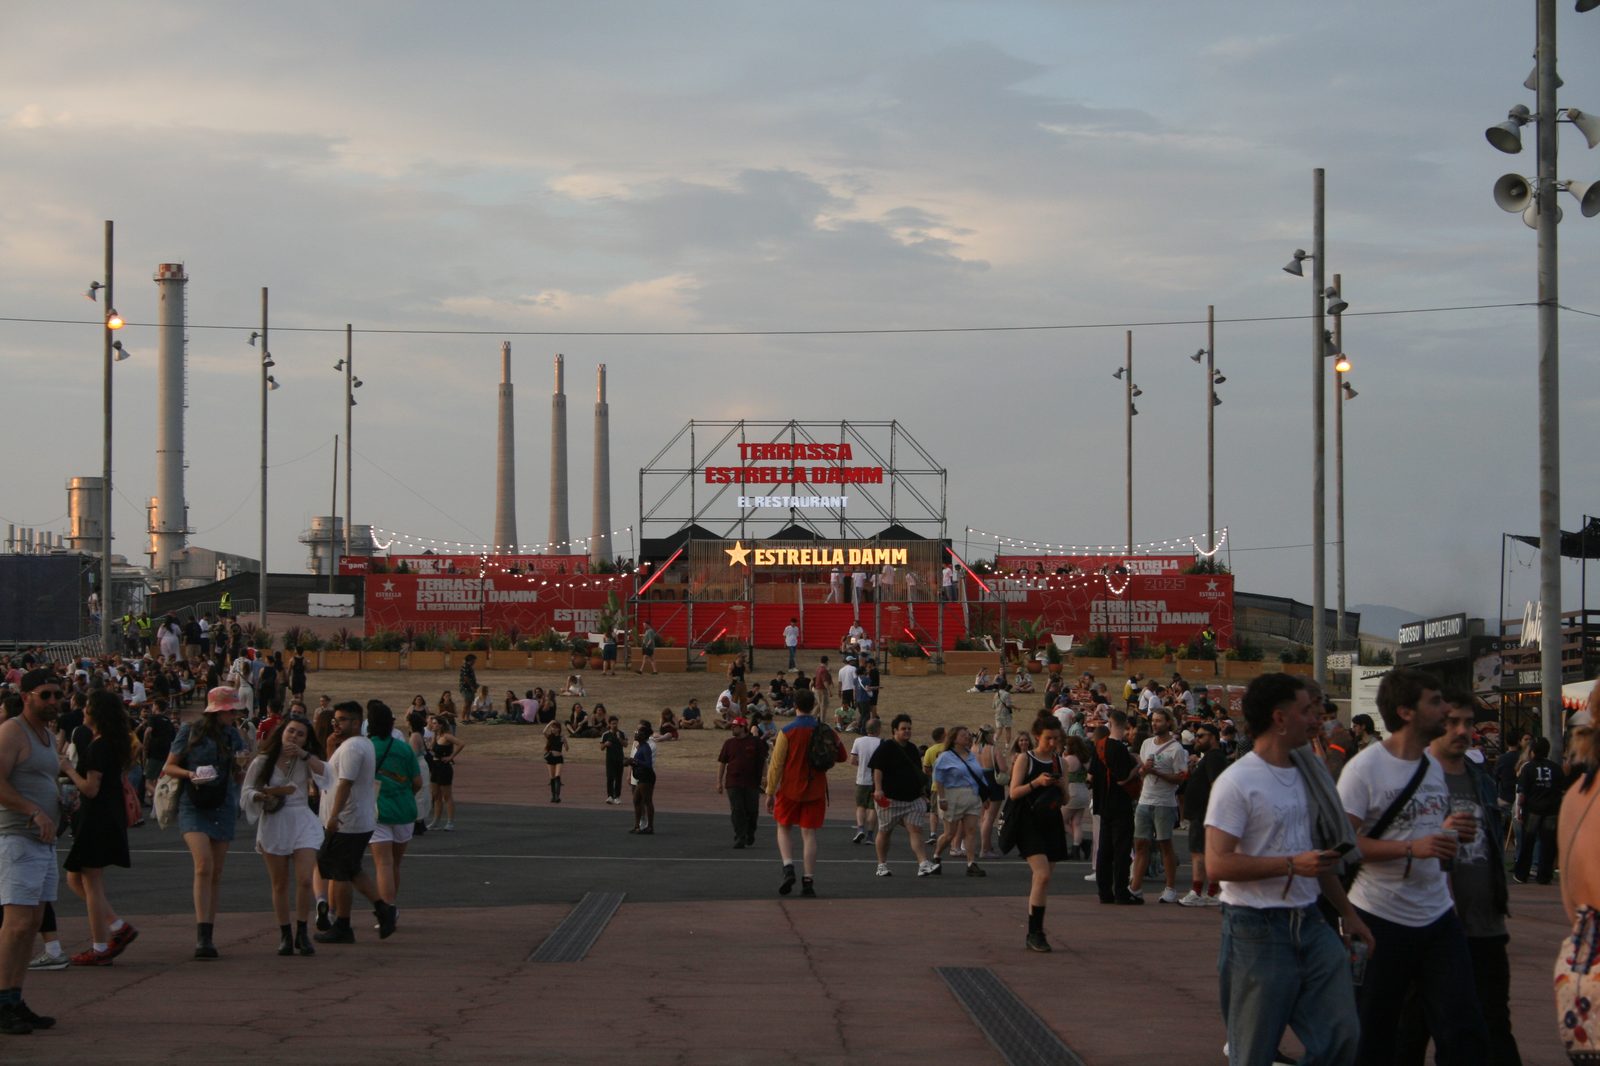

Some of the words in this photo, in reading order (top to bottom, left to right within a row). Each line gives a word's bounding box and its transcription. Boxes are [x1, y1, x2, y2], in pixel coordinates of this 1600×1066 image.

[738, 443, 852, 460] TERRASSA
[705, 467, 806, 483] ESTRELLA
[811, 467, 883, 483] DAMM
[737, 496, 752, 508] EL
[754, 496, 848, 508] RESTAURANT
[755, 549, 844, 565] ESTRELLA
[848, 549, 908, 565] DAMM
[1123, 559, 1179, 569] ESTRELLA
[416, 578, 494, 590] TERRASSA
[1144, 577, 1186, 591] 2025
[416, 591, 485, 602] ESTRELLA
[489, 591, 537, 602] DAMM
[1091, 600, 1167, 612] TERRASSA
[1089, 612, 1158, 624] ESTRELLA
[1161, 612, 1209, 624] DAMM
[1099, 624, 1158, 632] RESTAURANT
[1398, 625, 1420, 644] GROSSO
[1424, 617, 1461, 640] NAPOLETANO
[1535, 766, 1552, 781] 13
